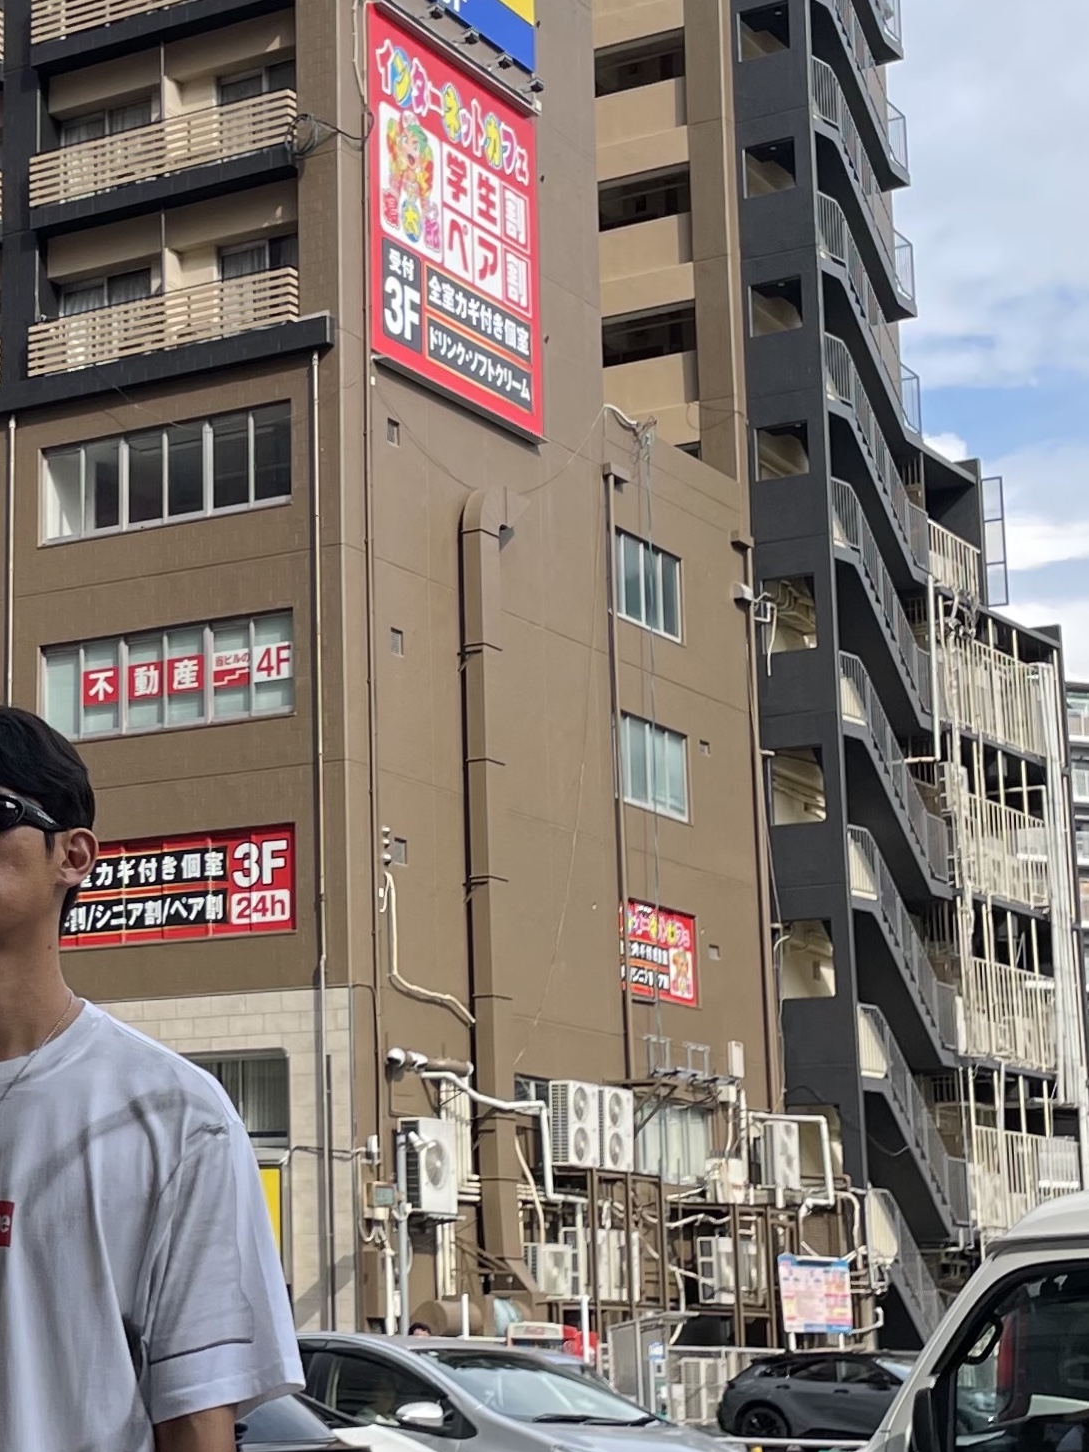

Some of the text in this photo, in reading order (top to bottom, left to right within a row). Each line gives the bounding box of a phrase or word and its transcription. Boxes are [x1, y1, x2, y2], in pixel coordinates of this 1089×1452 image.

[375, 39, 529, 187] インターネットカフェ
[445, 147, 529, 248] 学生割
[389, 248, 415, 282] 受付
[446, 220, 529, 308] ペア割
[383, 277, 420, 342] 3F
[428, 275, 530, 357] 全室カギ付き個室
[89, 659, 198, 701] 不動産
[257, 645, 291, 677] 4F
[232, 839, 289, 888] 3F
[64, 893, 286, 932] 割/シニア割/ペア割 24h
